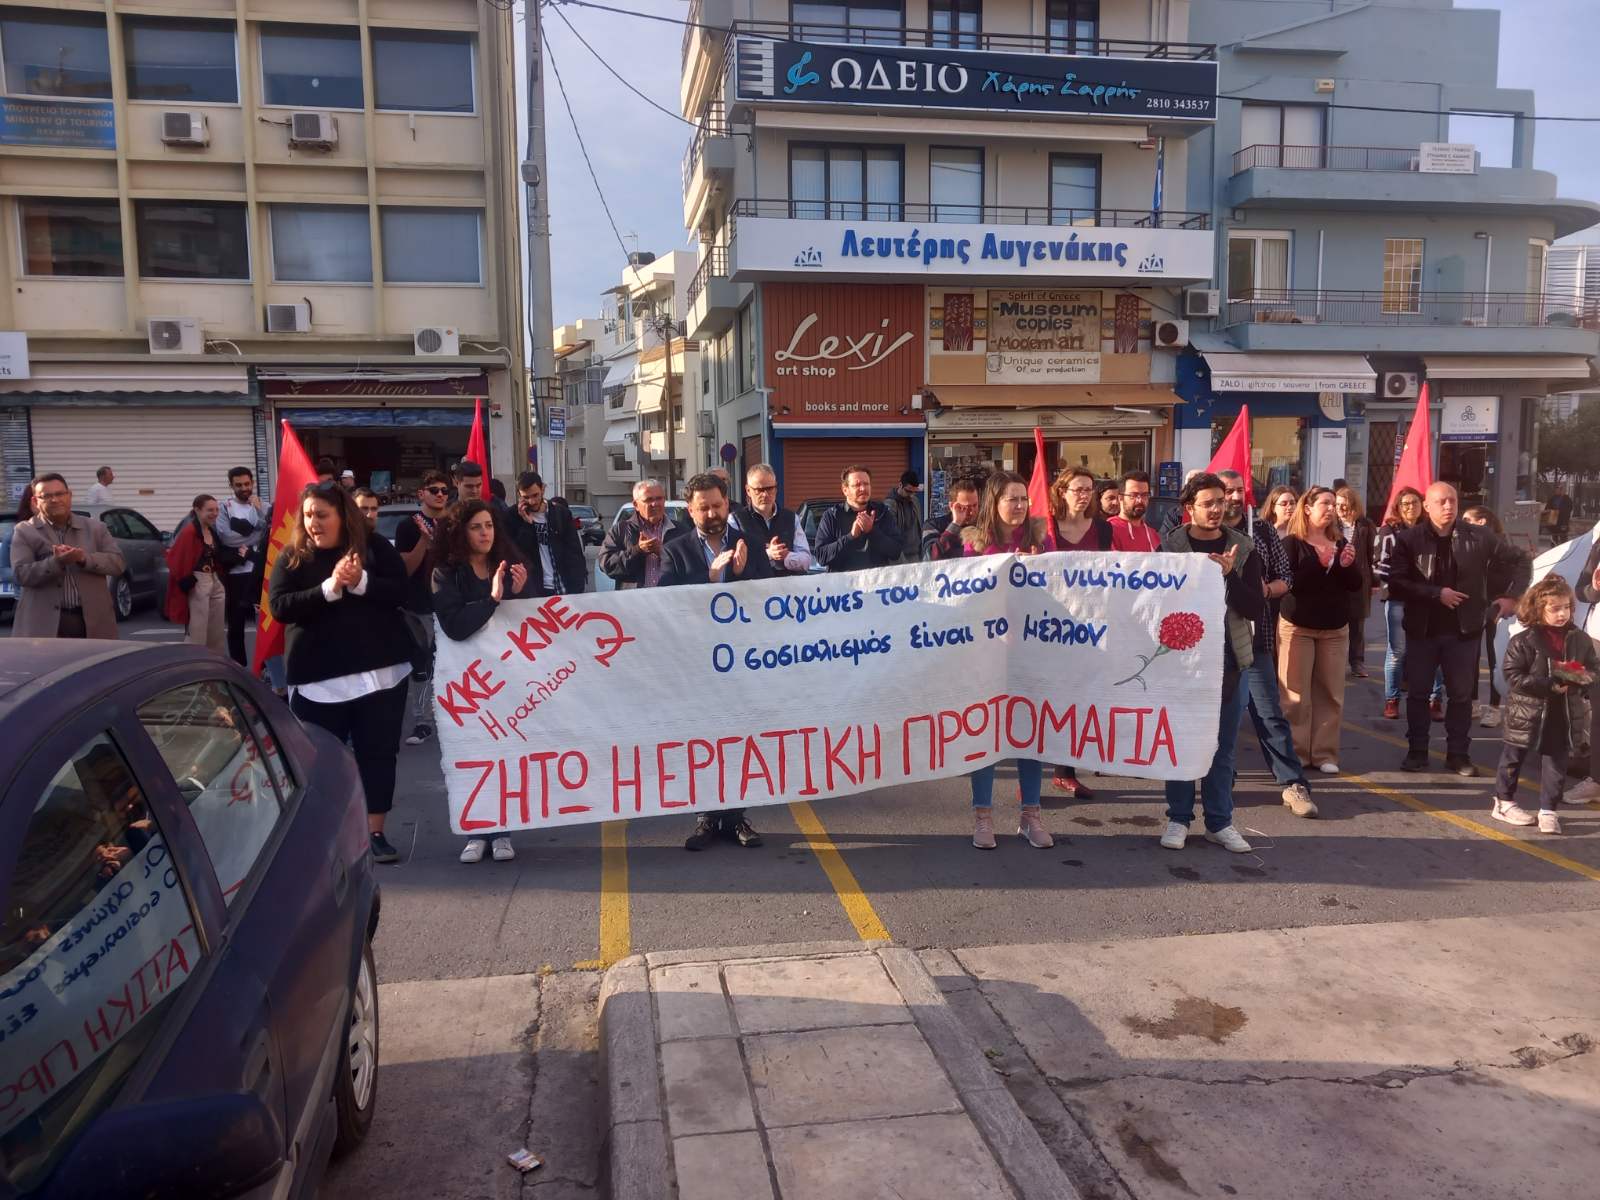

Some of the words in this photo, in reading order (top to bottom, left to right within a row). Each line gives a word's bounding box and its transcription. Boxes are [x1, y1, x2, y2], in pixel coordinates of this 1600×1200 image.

[829, 57, 968, 93] ΩΔΕΙΟ
[1146, 98, 1170, 109] 2810
[1172, 98, 1210, 111] 343537
[5, 115, 53, 124] MINISTRY
[55, 118, 67, 126] OF
[70, 119, 113, 128] TOURISM
[841, 228, 971, 265] Λευτέρης
[981, 232, 1128, 267] Αυγενάκης
[1015, 316, 1073, 333] copies
[1057, 335, 1085, 350] art
[1003, 356, 1043, 367] Unique
[1048, 356, 1099, 365] ceramics
[776, 365, 798, 376] art
[802, 365, 836, 378] shop
[1046, 366, 1086, 374] production
[1220, 379, 1240, 388] ZALO
[1319, 380, 1336, 389] from
[1339, 381, 1367, 390] GREECE
[805, 401, 837, 411] books
[840, 401, 858, 411] and
[710, 592, 751, 624] Οι
[764, 587, 864, 623] αγώνες
[875, 584, 919, 606] του
[935, 568, 997, 598] λαού
[1063, 562, 1187, 591] νικήσουν
[712, 643, 734, 672] Ο
[744, 630, 891, 666] σοσιαλισμός
[984, 617, 1008, 640] το
[1024, 610, 1107, 646] μέλλον
[454, 750, 593, 831] ΖΗΤΩ
[612, 744, 641, 813] Η
[656, 723, 881, 808] ΕΡΓΑΤΙΚΗ
[903, 695, 1178, 775] ΠΡΩΤΟΜΑΓΙΑ
